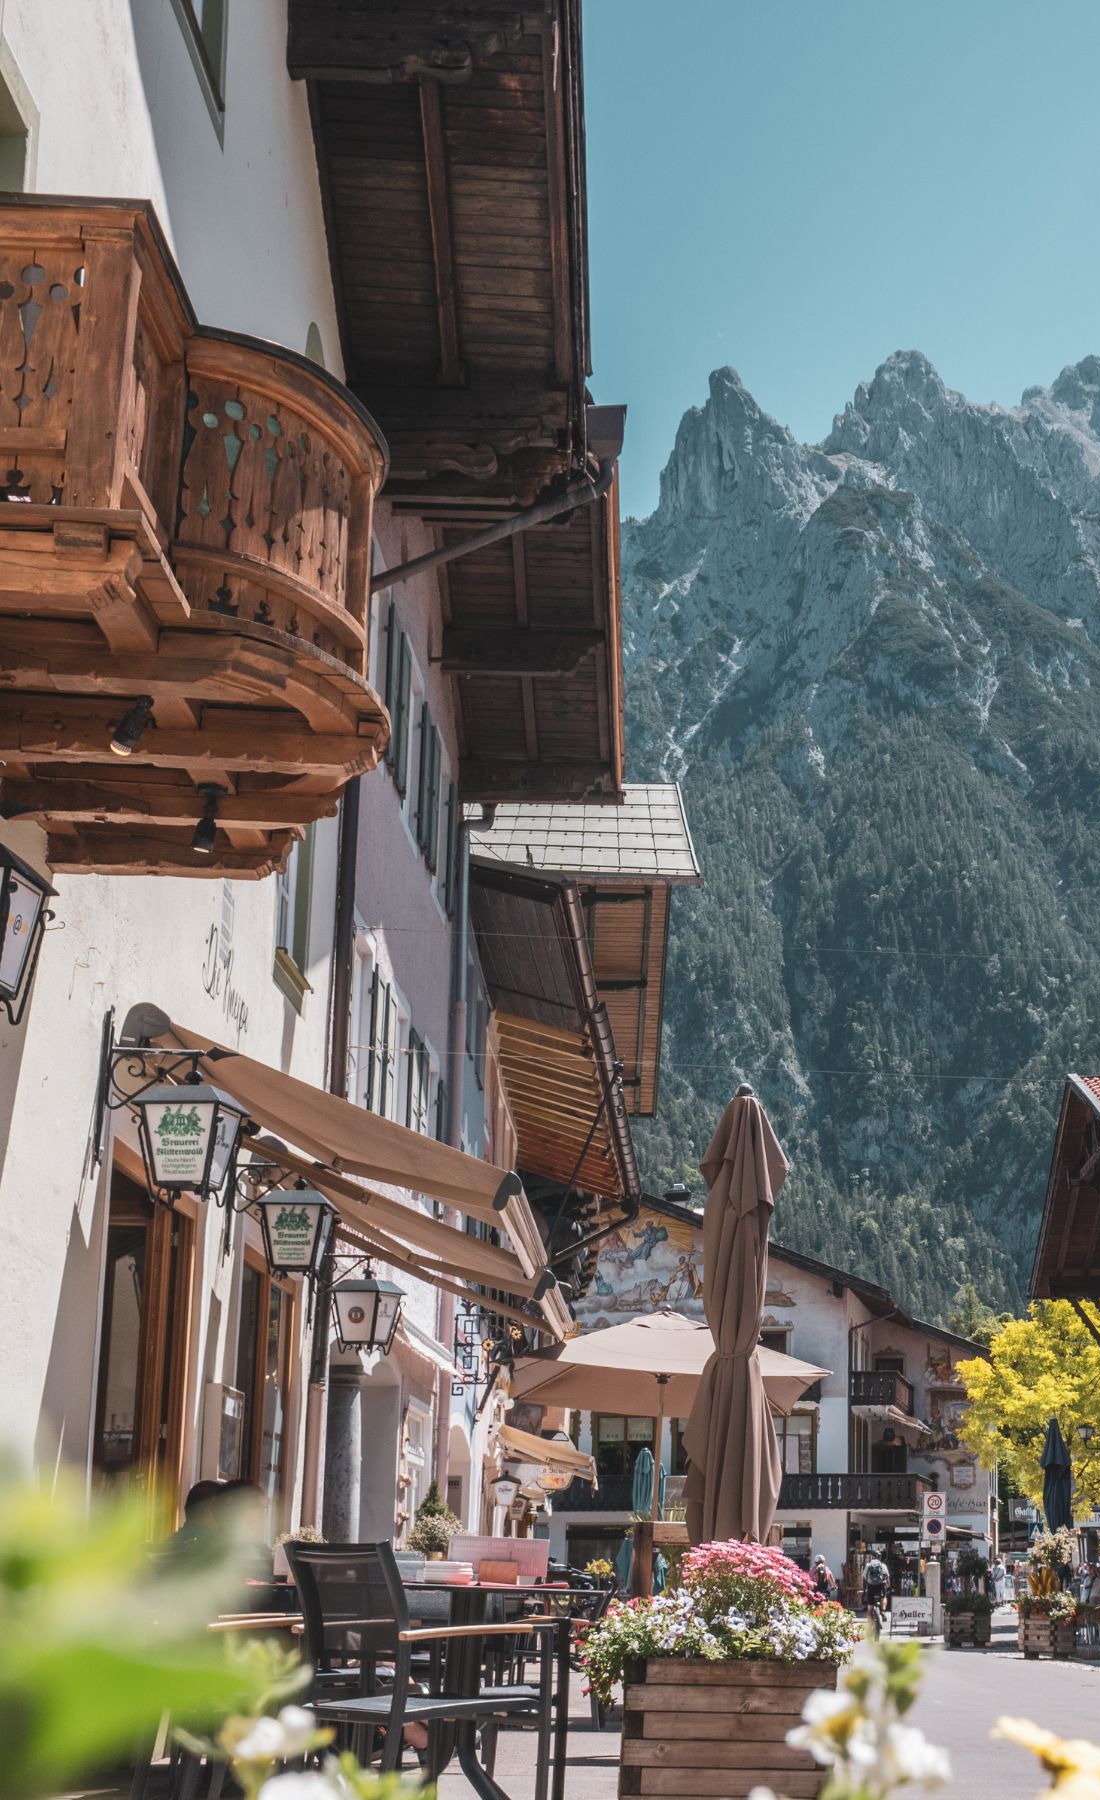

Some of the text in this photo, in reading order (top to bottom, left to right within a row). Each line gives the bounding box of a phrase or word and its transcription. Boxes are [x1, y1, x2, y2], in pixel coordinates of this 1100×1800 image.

[161, 1137, 199, 1147] Brauerei
[156, 1147, 204, 1156] Mittenwald
[277, 1231, 308, 1239] Brauerei
